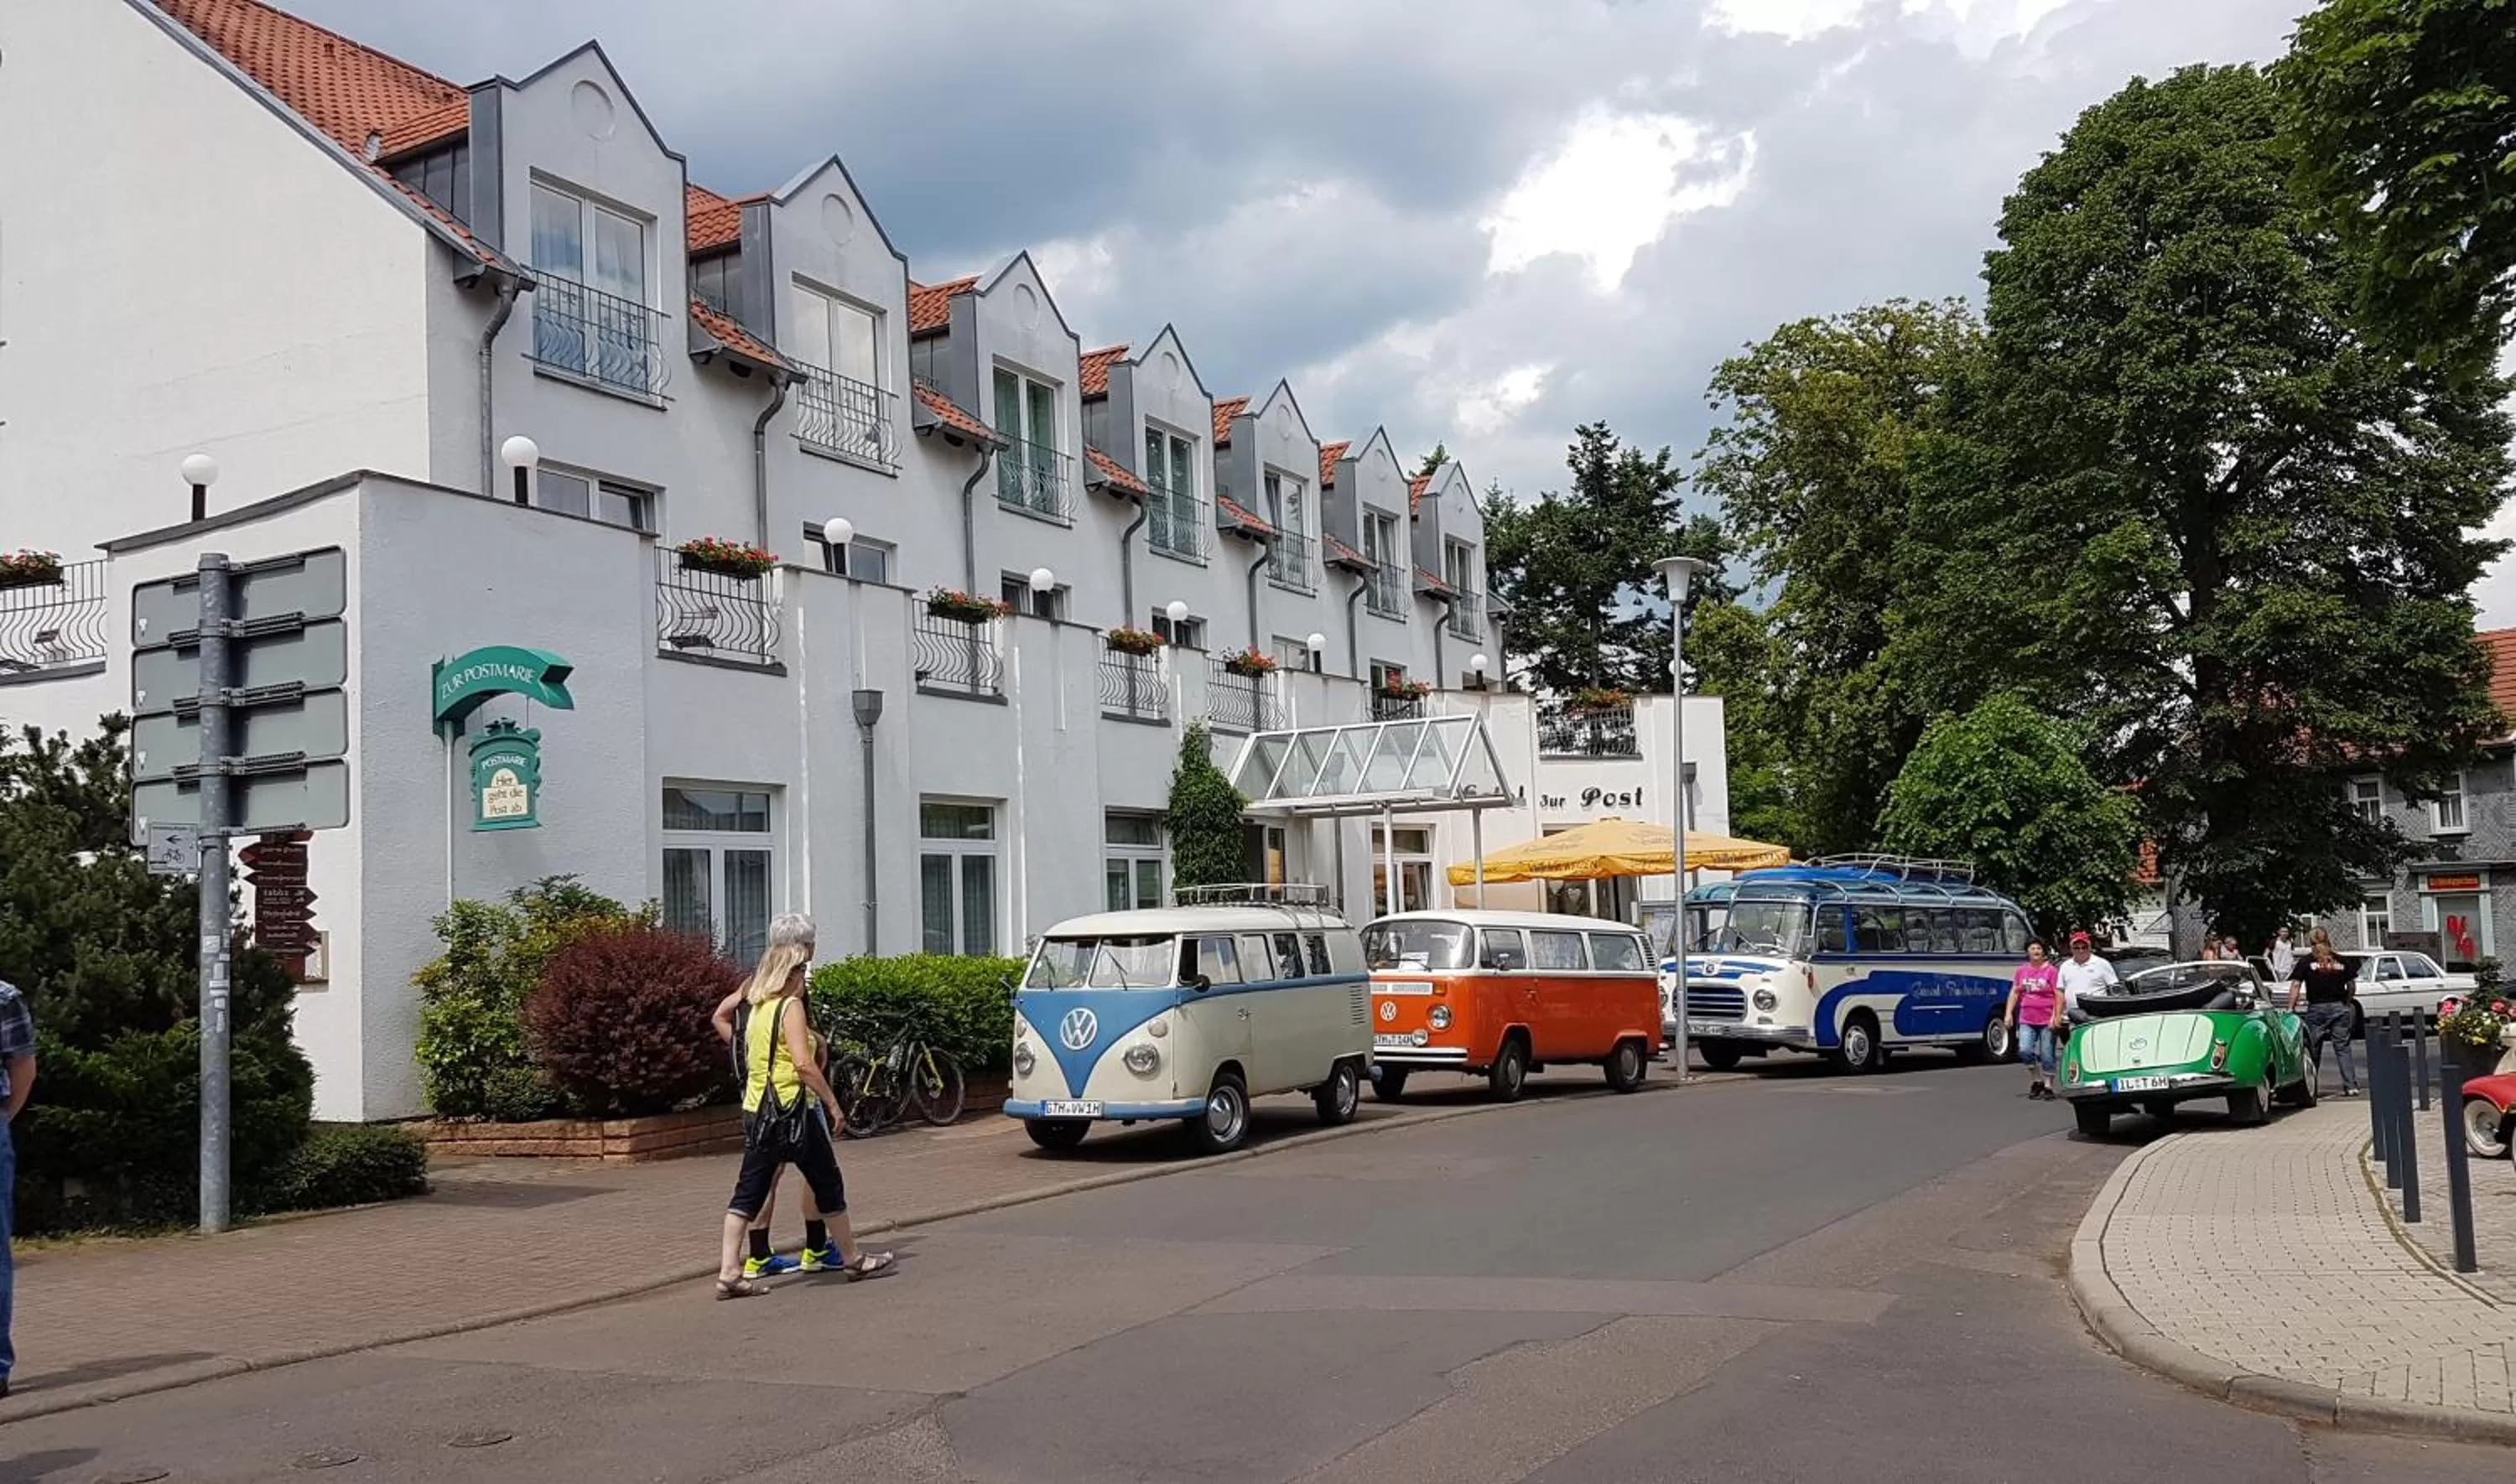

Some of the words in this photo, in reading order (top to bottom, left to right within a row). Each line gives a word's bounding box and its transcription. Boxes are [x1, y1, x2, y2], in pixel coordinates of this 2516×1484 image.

[442, 673, 465, 699] ZUR
[464, 662, 536, 685] POSTMARIE
[1579, 786, 1644, 808] Post
[1060, 1007, 1098, 1050] VW
